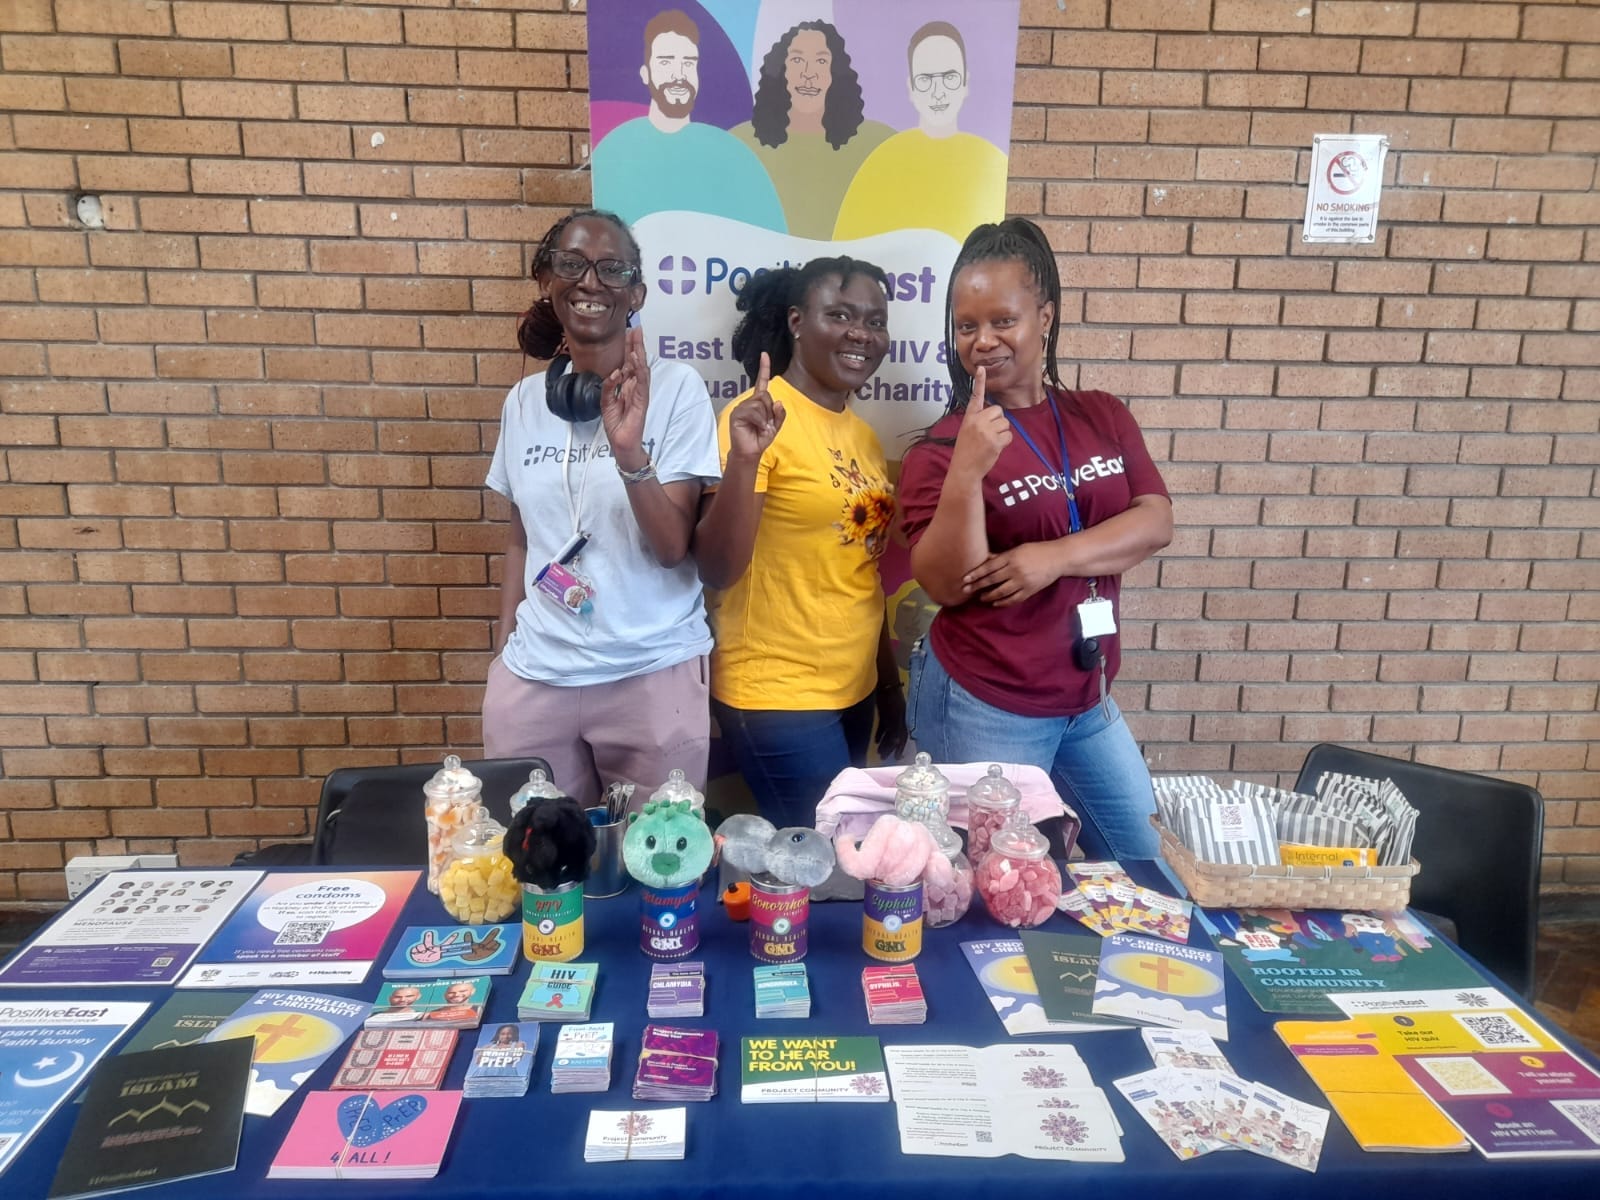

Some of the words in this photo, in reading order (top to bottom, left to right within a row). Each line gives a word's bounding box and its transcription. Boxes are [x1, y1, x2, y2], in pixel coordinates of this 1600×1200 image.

[1316, 203, 1329, 211] NO
[1330, 203, 1370, 212] SMOKING
[658, 336, 724, 361] East
[1295, 851, 1339, 861] Internal
[1112, 935, 1133, 943] HIV
[1138, 940, 1212, 958] KNOWLEDGE
[1130, 943, 1213, 963] CHRISTIANITY
[550, 969, 577, 980] HIV
[1251, 967, 1336, 976] ROOTED
[1339, 968, 1363, 976] IN
[547, 981, 573, 990] GUIDE
[1260, 978, 1387, 988] COMMUNITY
[286, 994, 364, 1011] KNOWLEDGE
[0, 1007, 109, 1018] PositiveEast
[272, 1000, 359, 1018] CHRISTIANITY
[1, 1029, 36, 1038] part
[39, 1037, 96, 1047] Survey
[748, 1039, 777, 1050] WE
[782, 1039, 837, 1050] WANT
[749, 1050, 774, 1061] TO
[780, 1050, 830, 1060] HEAR
[479, 1056, 521, 1068] PrEP?
[749, 1061, 804, 1072] FROM
[809, 1061, 857, 1071] YOU!
[382, 1100, 418, 1127] PrEP
[330, 1151, 340, 1164] 4
